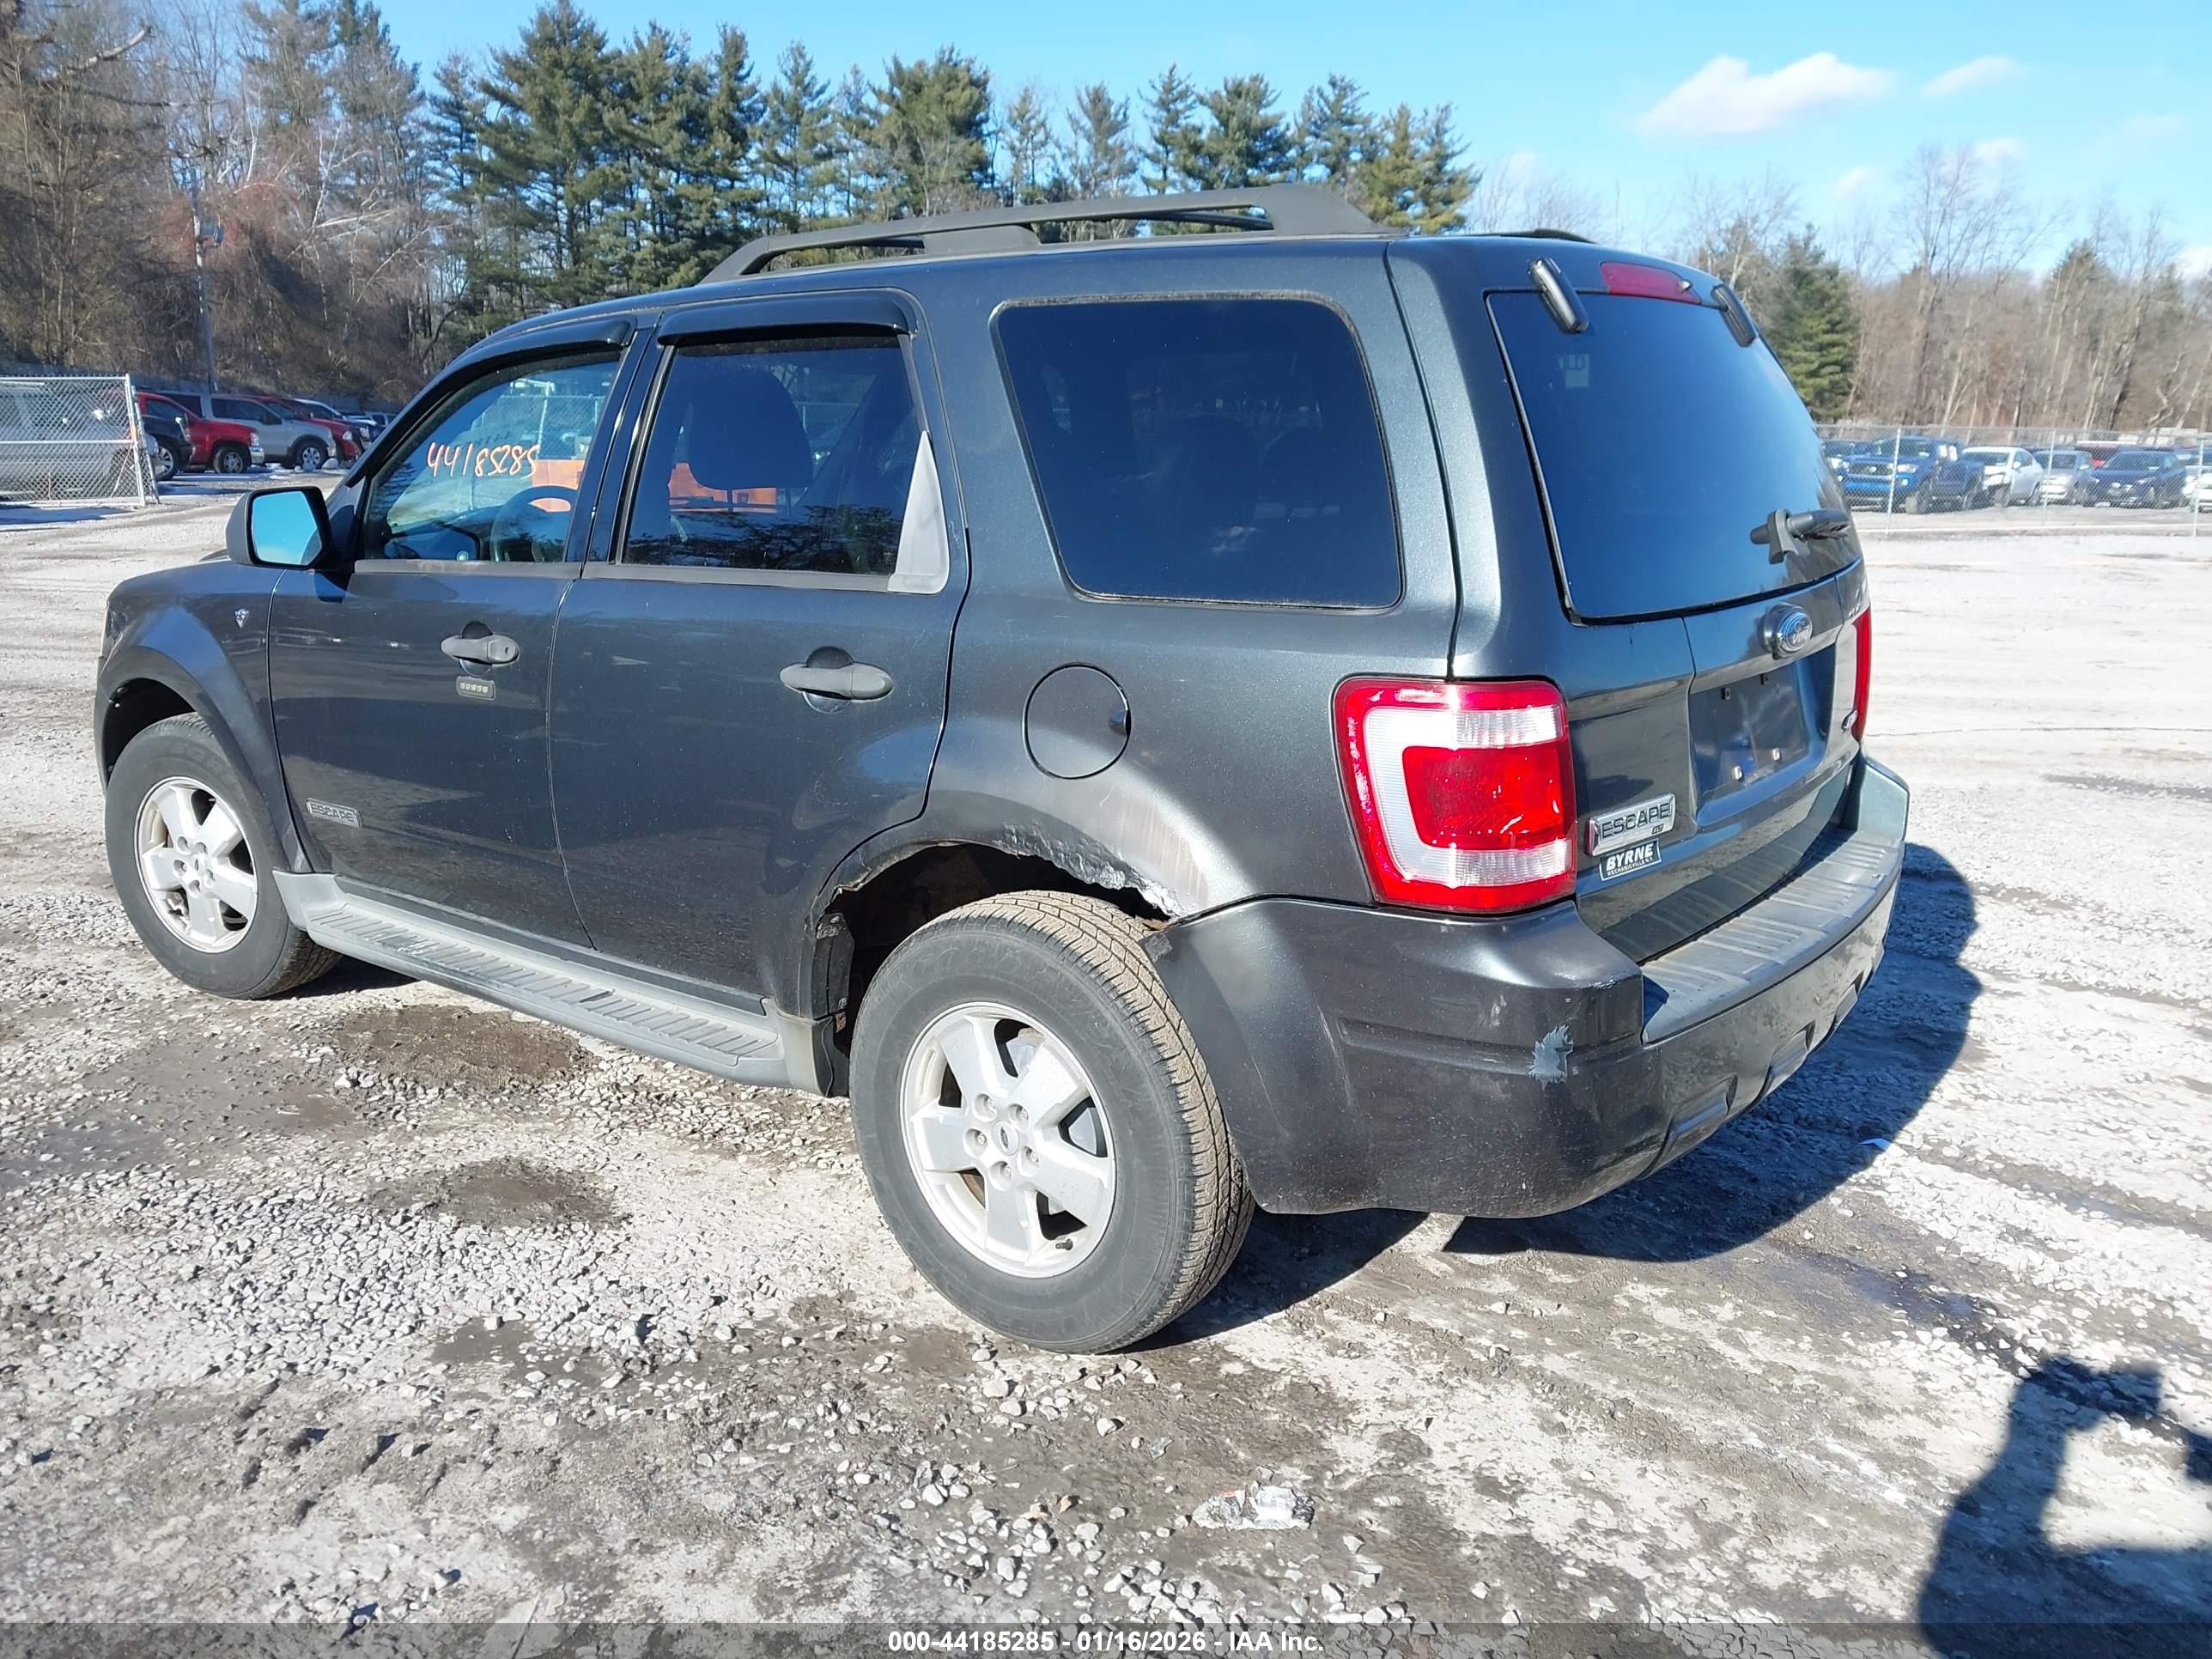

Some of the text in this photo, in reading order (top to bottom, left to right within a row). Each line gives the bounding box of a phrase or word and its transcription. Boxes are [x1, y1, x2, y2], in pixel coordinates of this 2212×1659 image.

[427, 441, 540, 480] 44185285
[312, 805, 355, 823] ESCAPE
[1601, 802, 1670, 839] ESCAPE
[1606, 842, 1654, 872] BYRNE
